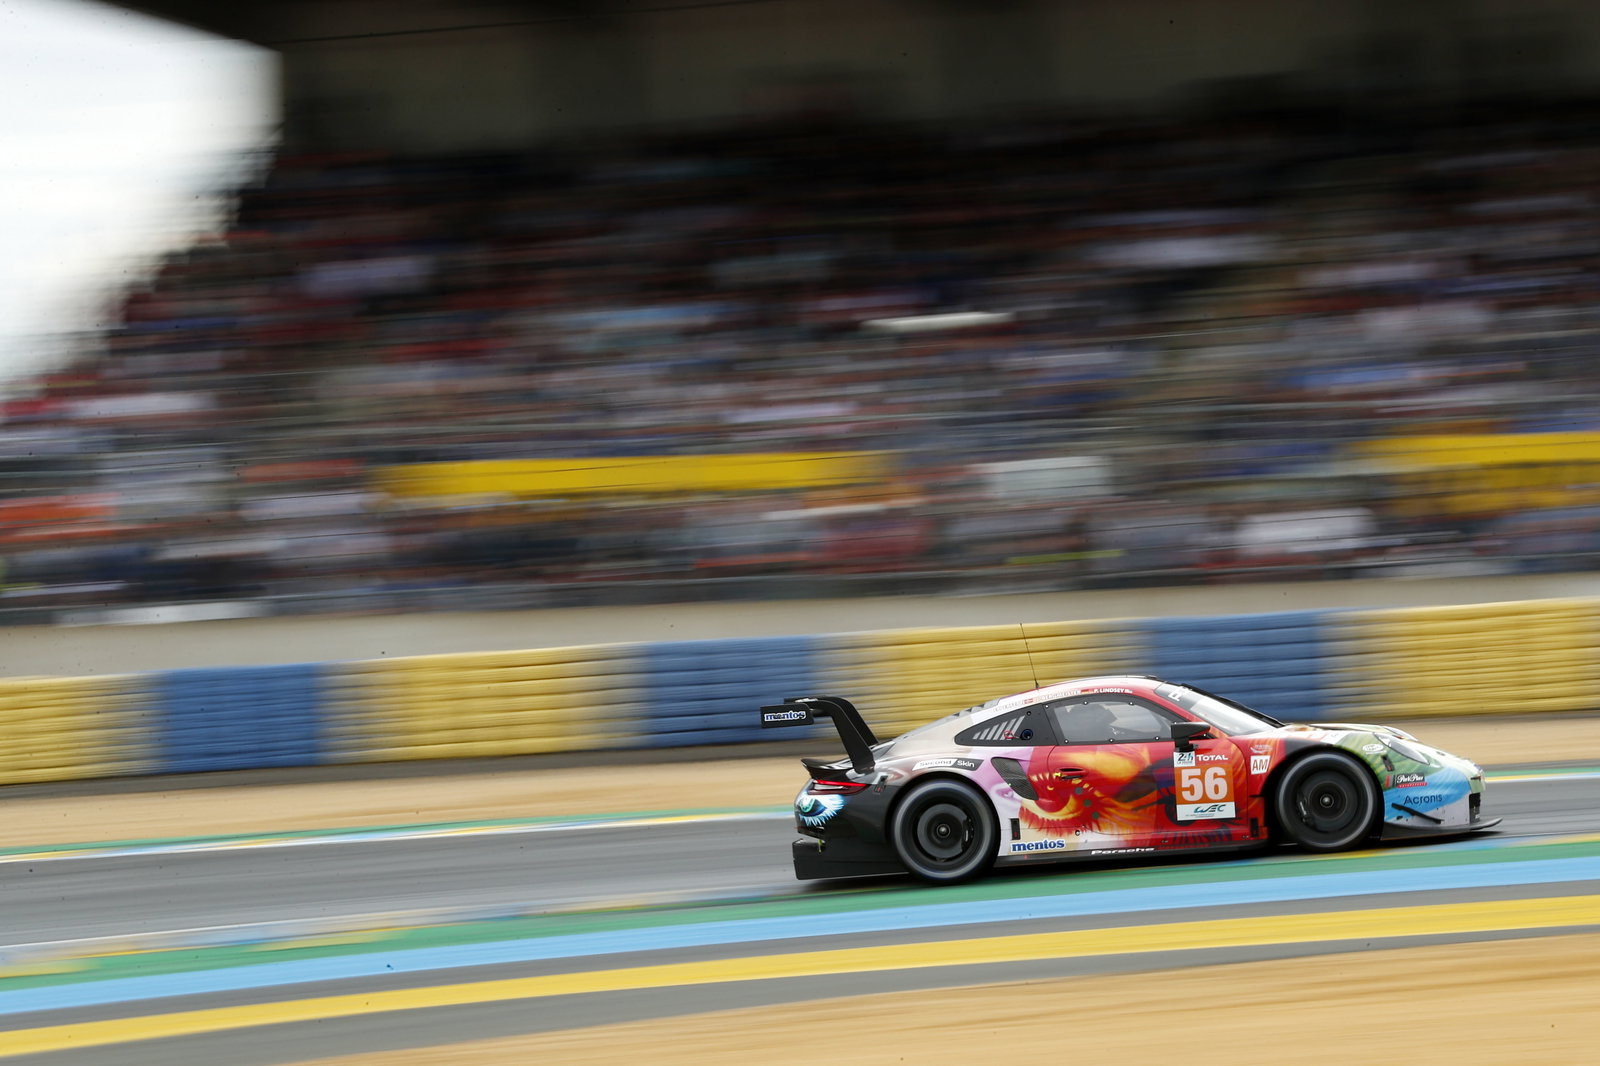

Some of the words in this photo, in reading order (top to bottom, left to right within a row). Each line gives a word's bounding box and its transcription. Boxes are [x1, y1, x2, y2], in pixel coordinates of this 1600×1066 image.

[764, 711, 806, 721] mentos
[1252, 758, 1268, 771] AM
[1181, 766, 1228, 802] 56
[1403, 794, 1443, 806] Acronis
[1193, 804, 1227, 813] WEC
[1012, 839, 1065, 852] mentos
[1091, 847, 1155, 855] Porsche
